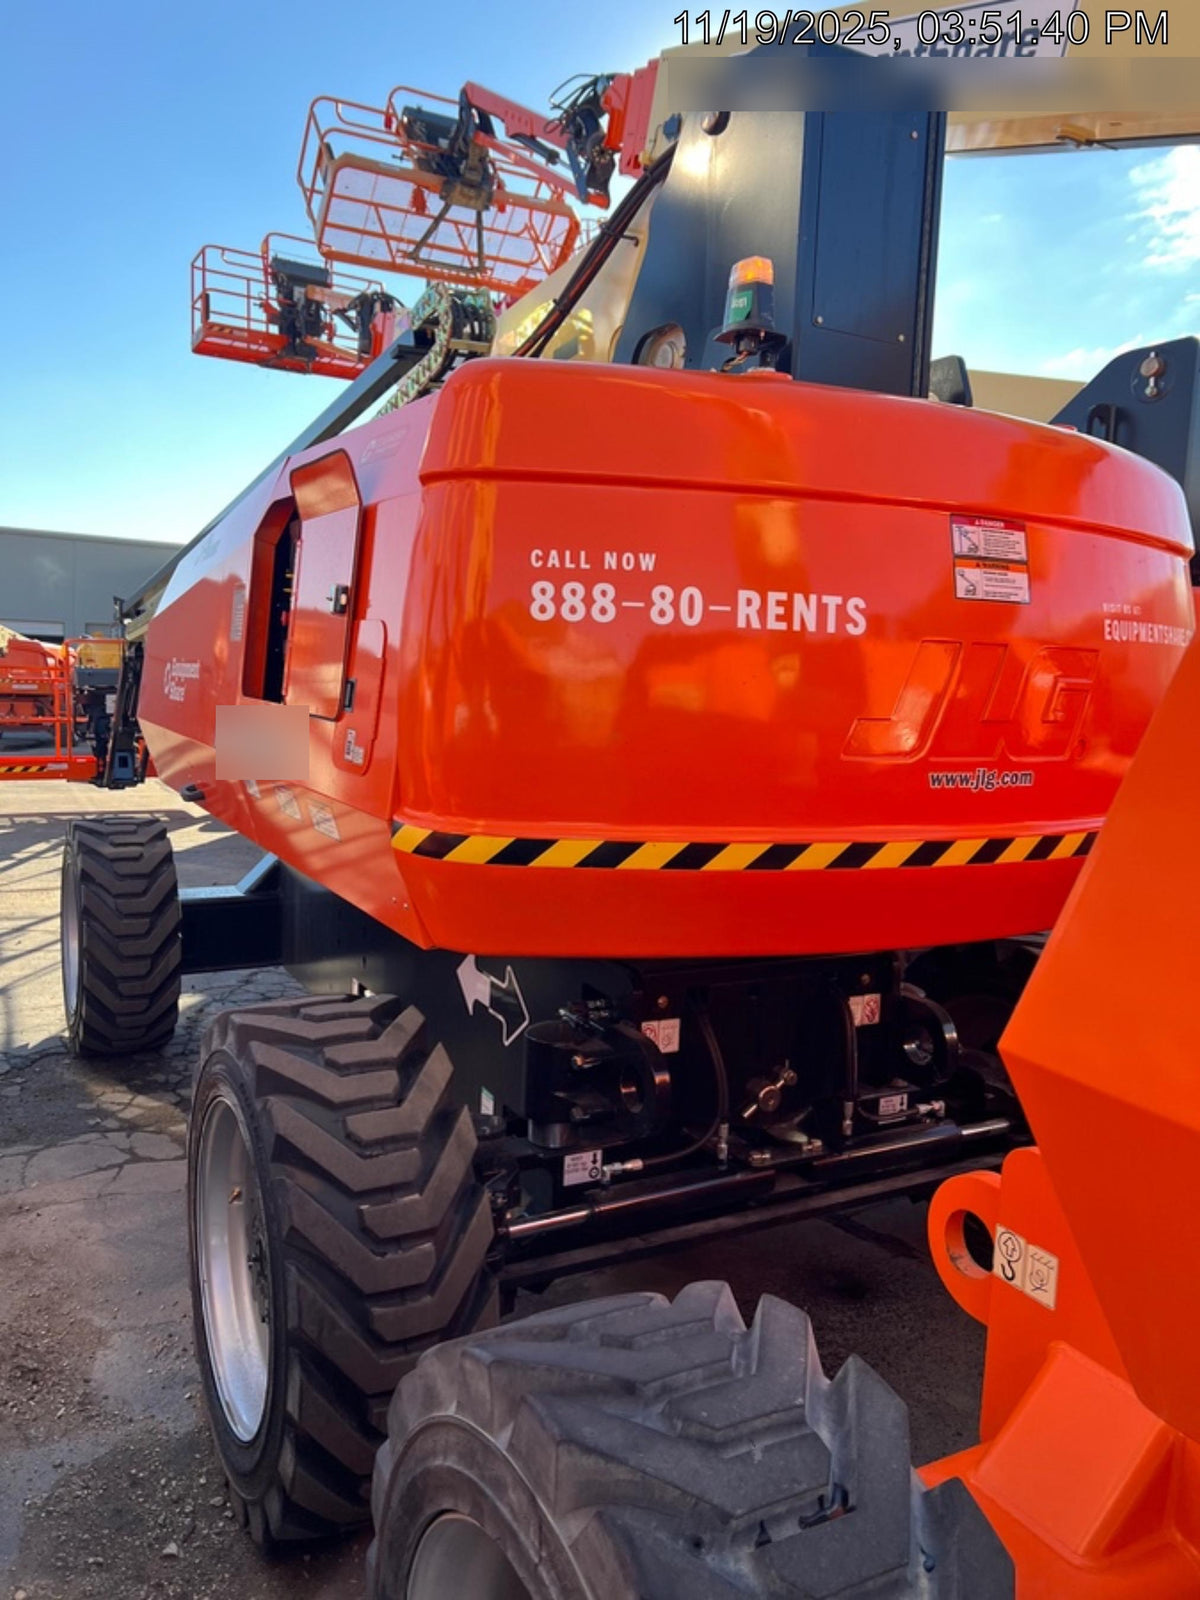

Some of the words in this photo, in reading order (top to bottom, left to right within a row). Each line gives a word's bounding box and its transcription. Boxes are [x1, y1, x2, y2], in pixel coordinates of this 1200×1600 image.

[530, 549, 591, 568] CALL
[604, 551, 656, 571] NOW
[530, 580, 867, 635] 888-80-RENTS
[841, 638, 1100, 763] JLG
[929, 768, 1034, 792] www.jlg.com
